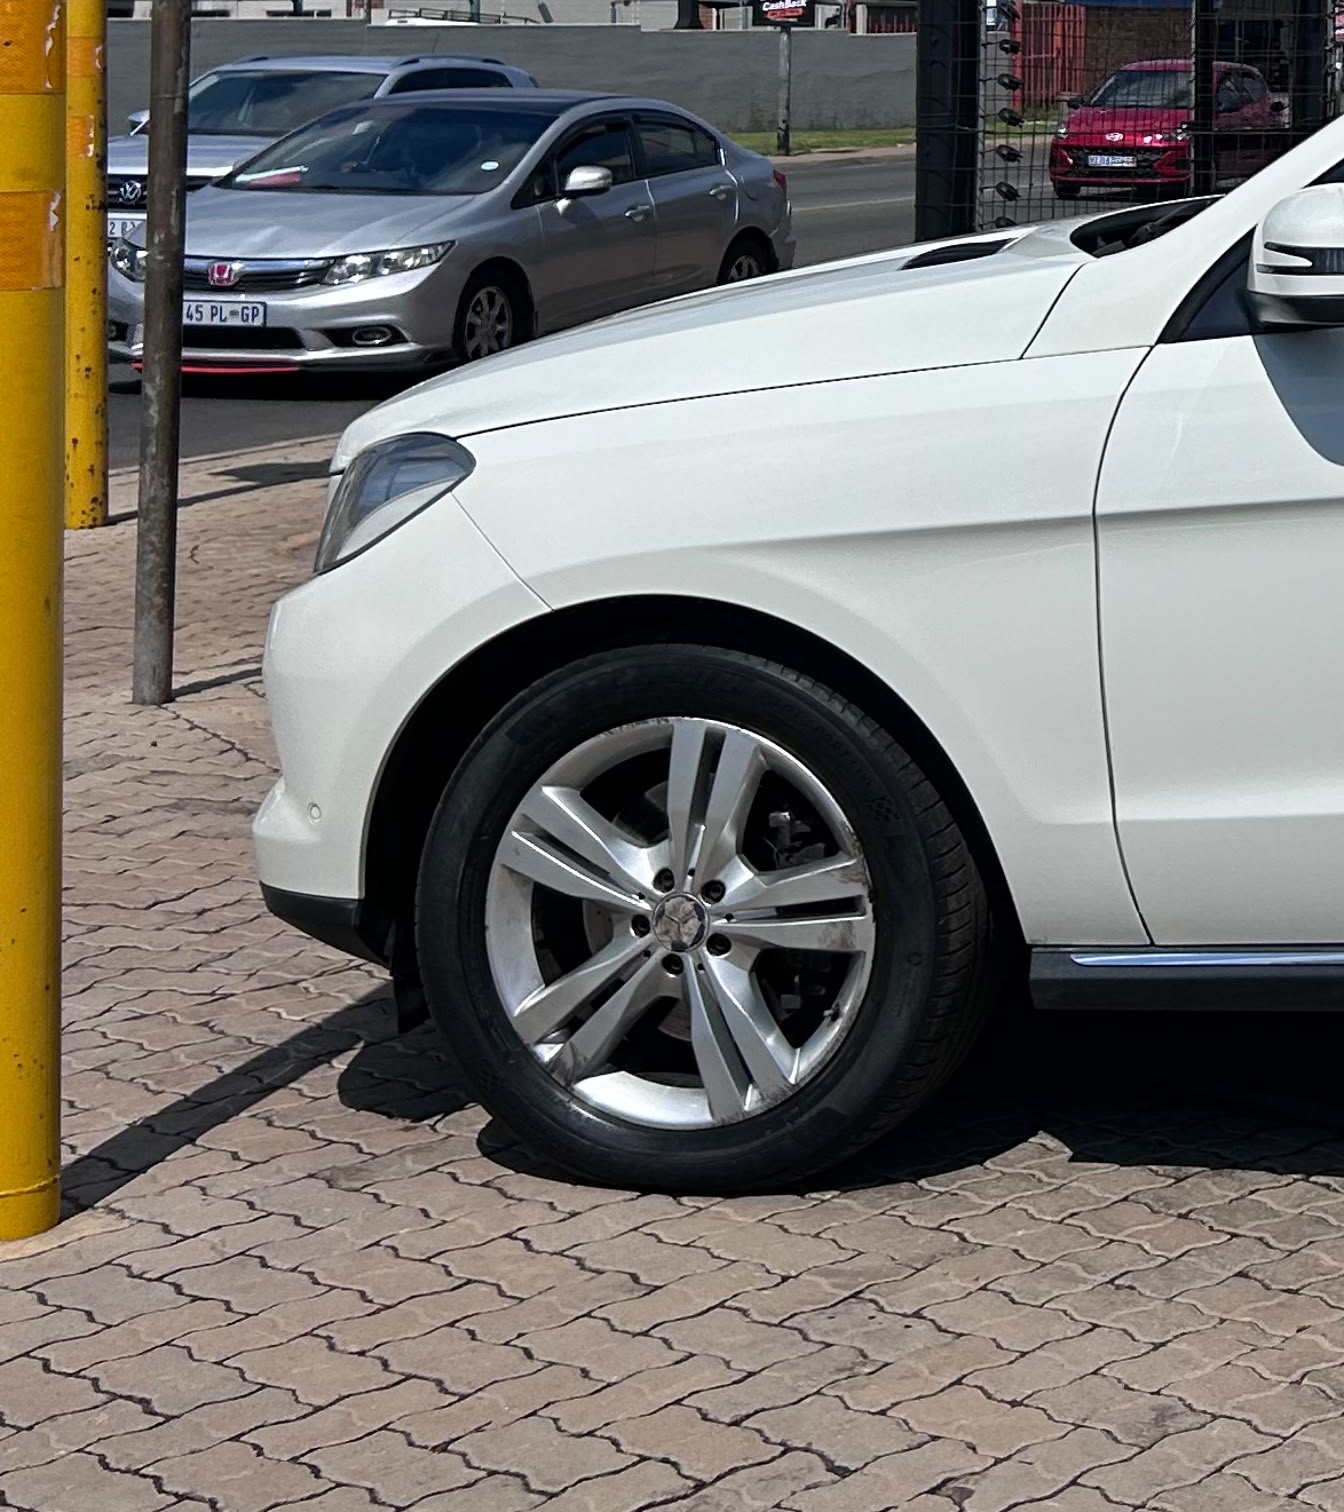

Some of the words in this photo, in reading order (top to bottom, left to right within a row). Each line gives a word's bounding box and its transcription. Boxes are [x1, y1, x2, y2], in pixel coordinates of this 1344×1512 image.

[186, 303, 204, 322] 45
[210, 304, 228, 323] PL
[240, 305, 260, 323] GP
